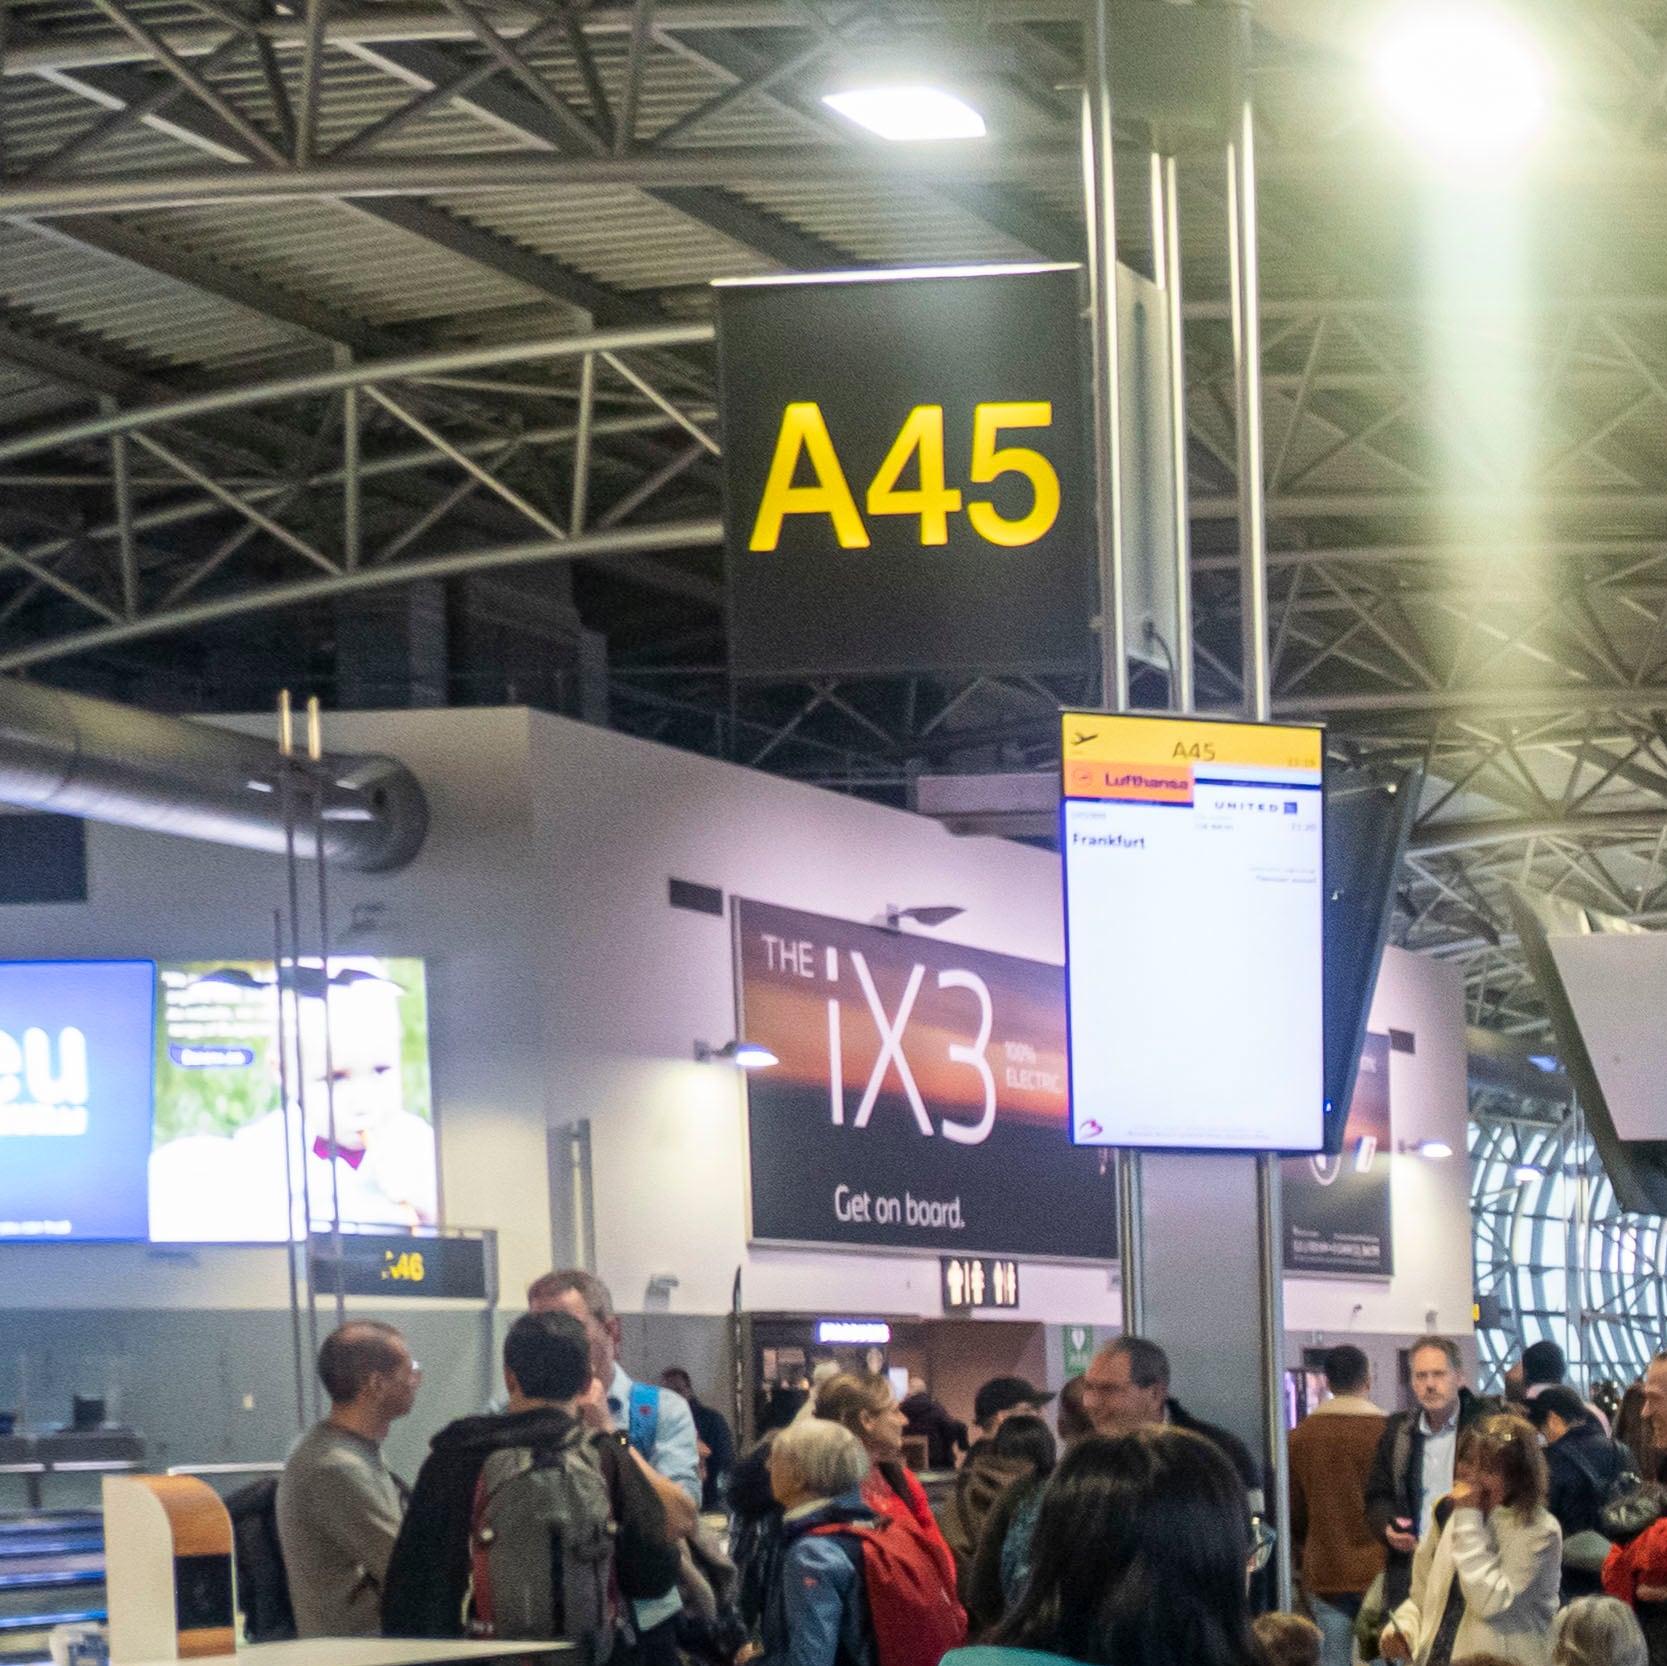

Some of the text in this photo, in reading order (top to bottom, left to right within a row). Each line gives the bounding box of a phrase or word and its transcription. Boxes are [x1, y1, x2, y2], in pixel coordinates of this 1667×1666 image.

[749, 401, 1061, 552] A45
[1172, 742, 1216, 761] A45
[1105, 773, 1188, 790] Lufthansa
[1215, 801, 1278, 813] UNITED
[1073, 833, 1145, 849] Frankfurt
[760, 934, 997, 1145] THE iX3
[834, 1184, 966, 1229] Get on board.
